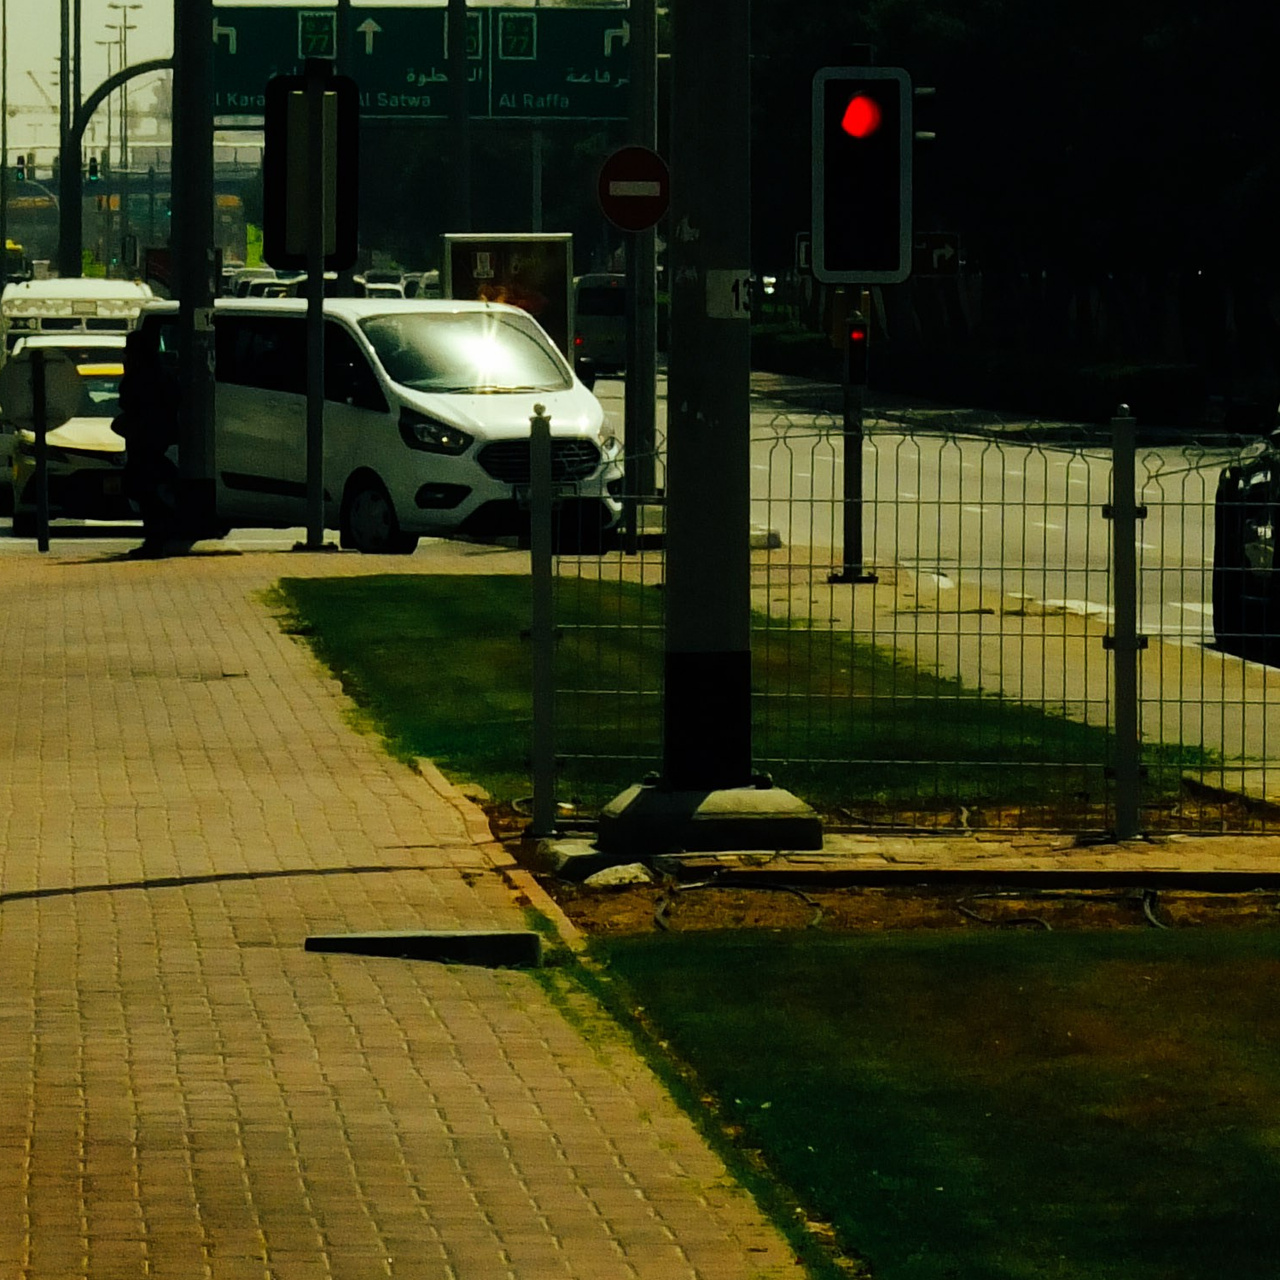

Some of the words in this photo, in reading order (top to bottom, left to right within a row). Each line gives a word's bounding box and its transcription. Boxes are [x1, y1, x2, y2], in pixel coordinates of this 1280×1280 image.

[227, 93, 266, 107] Kara
[377, 92, 431, 108] Satwa
[499, 93, 516, 108] Al
[523, 93, 570, 109] Raffa
